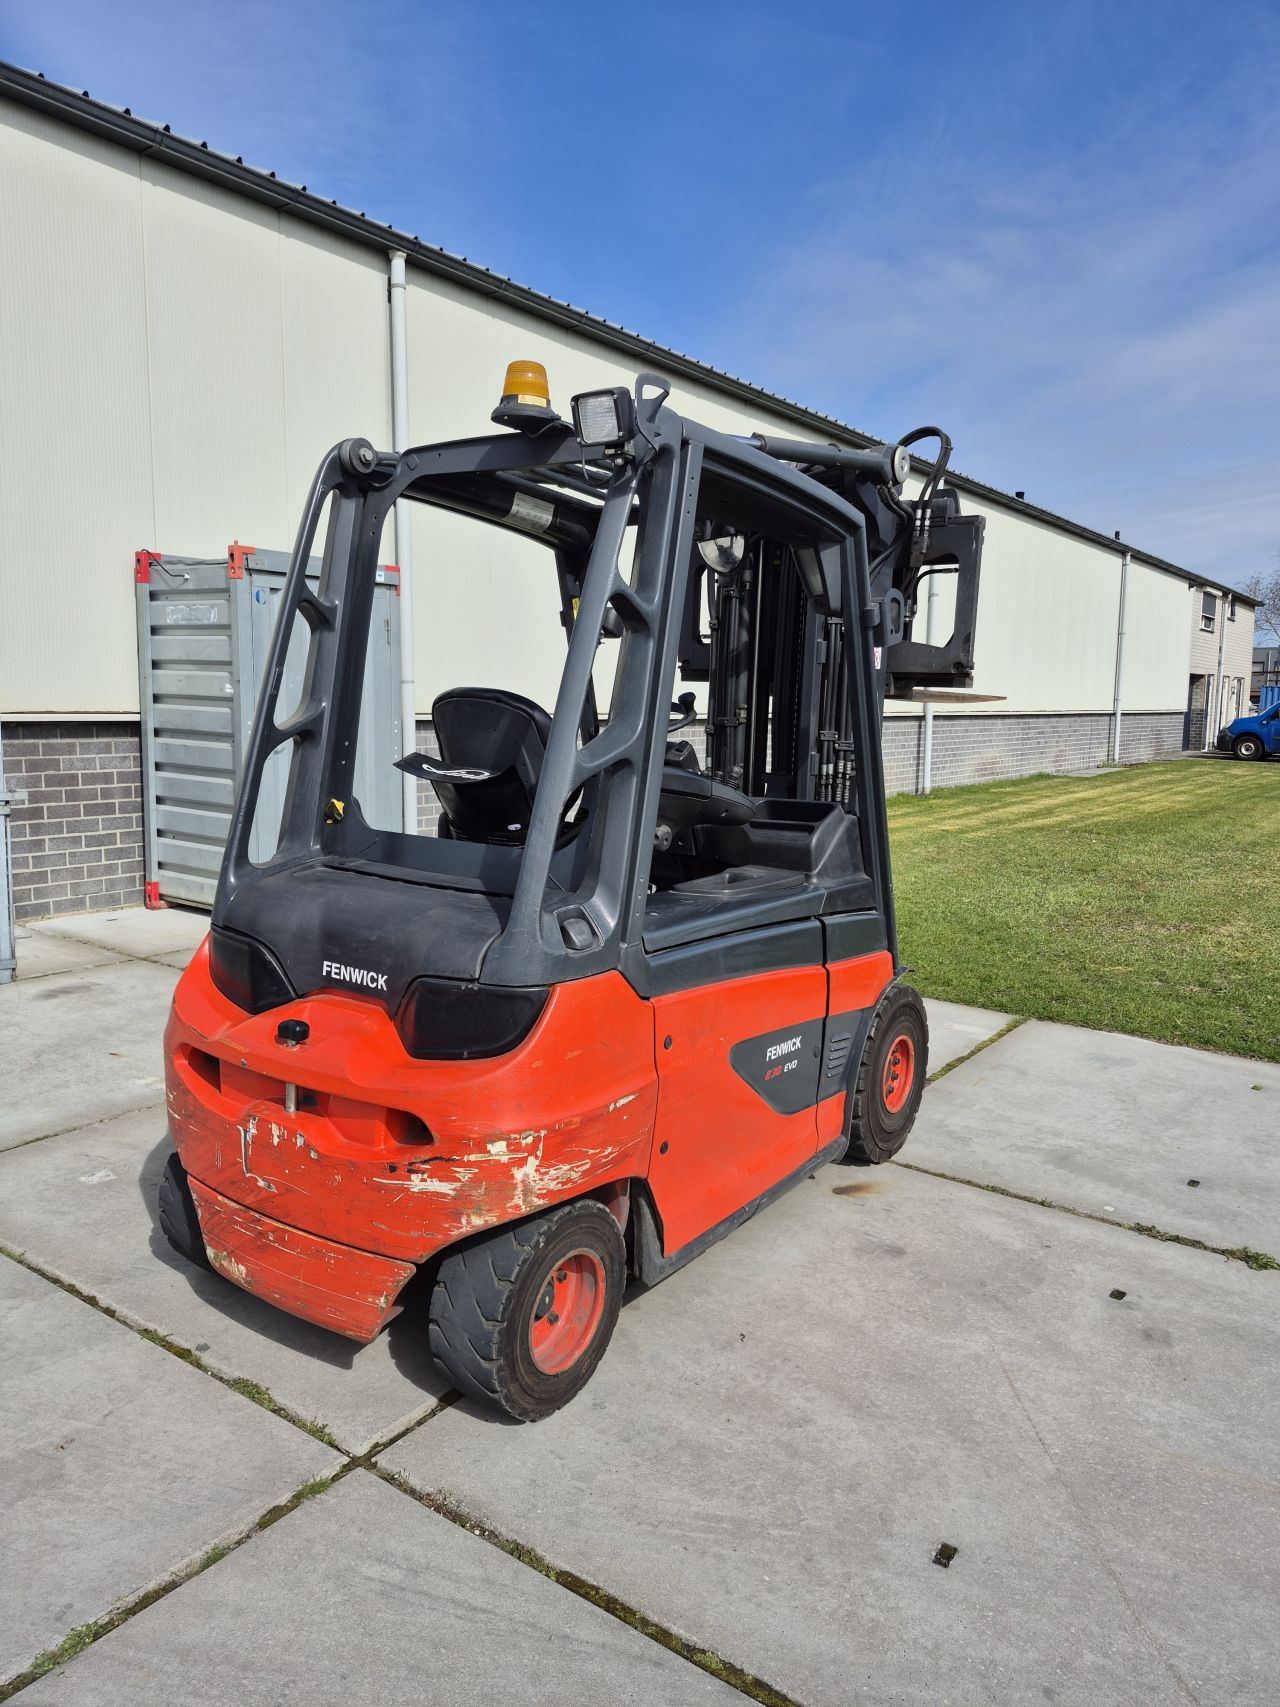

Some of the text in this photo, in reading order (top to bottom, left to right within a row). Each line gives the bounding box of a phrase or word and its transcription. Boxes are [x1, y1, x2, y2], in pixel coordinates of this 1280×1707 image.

[322, 960, 388, 991] FENWICK
[766, 1035, 802, 1062] FENWICK
[784, 1060, 798, 1072] EVO
